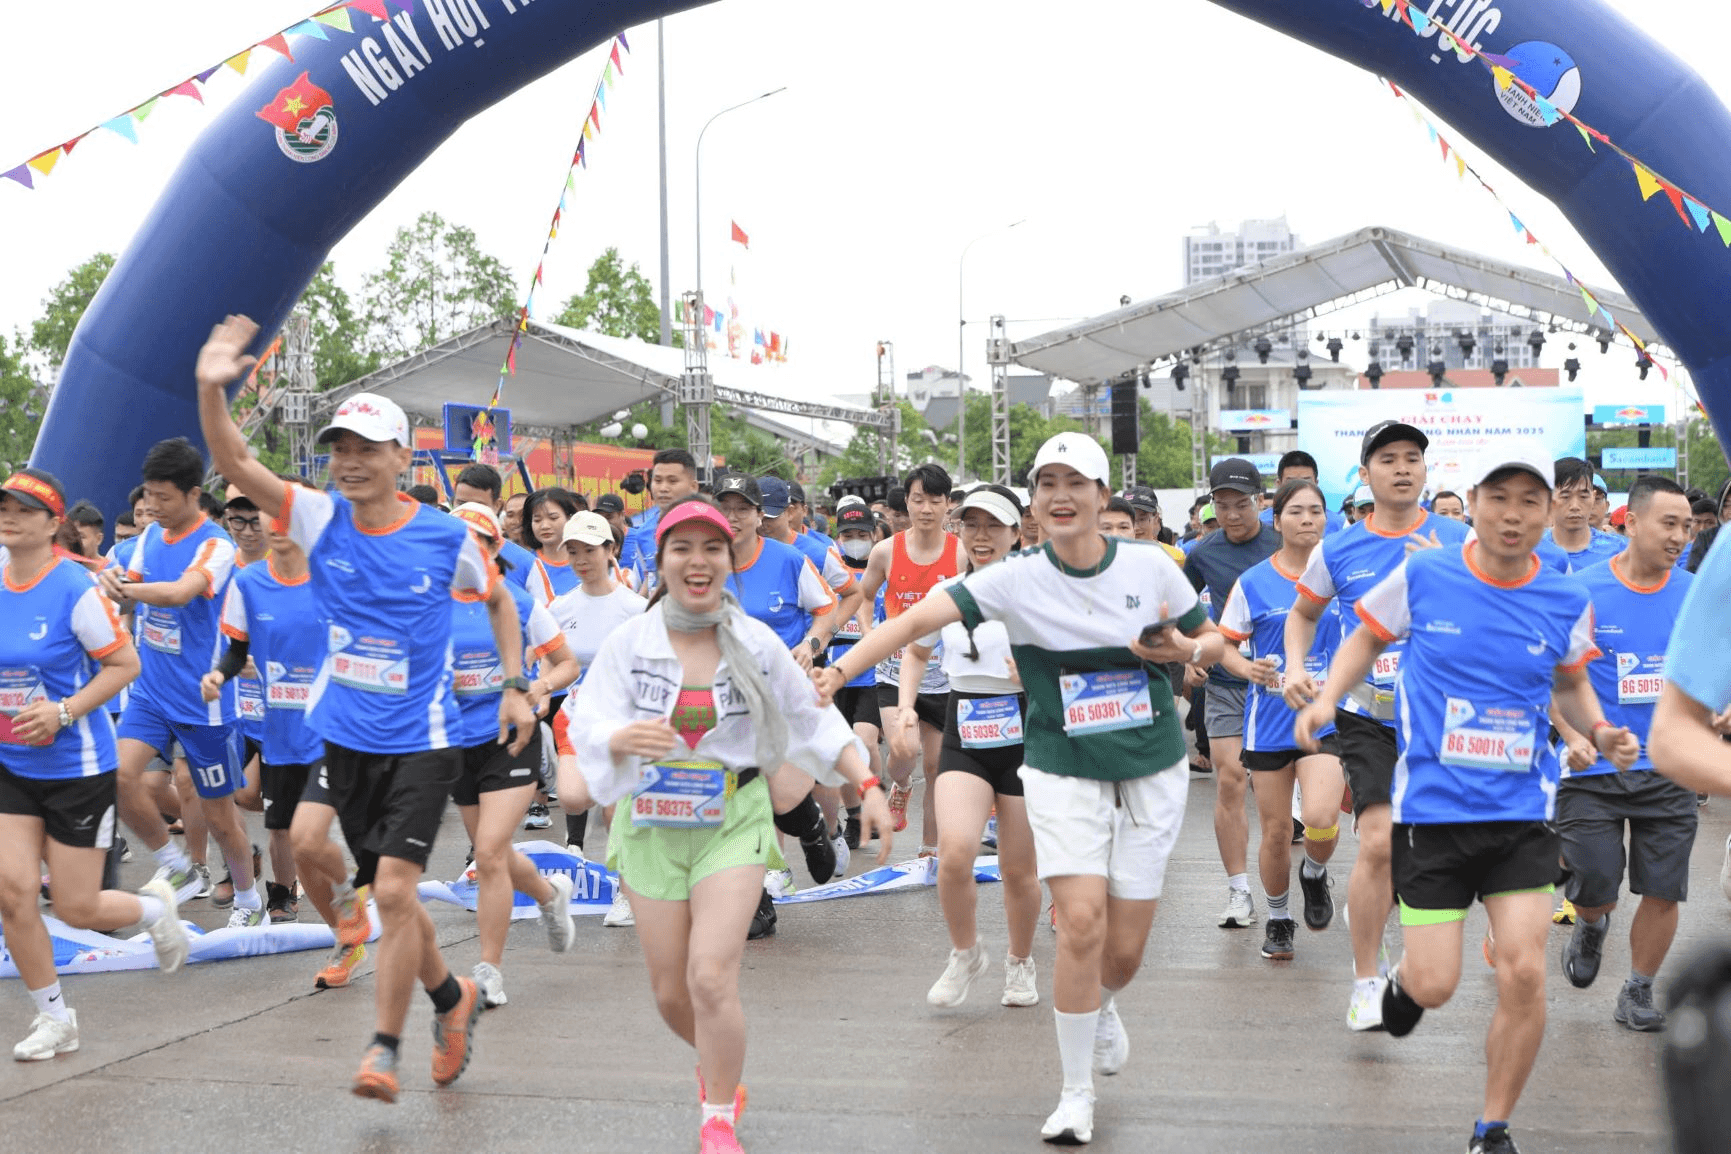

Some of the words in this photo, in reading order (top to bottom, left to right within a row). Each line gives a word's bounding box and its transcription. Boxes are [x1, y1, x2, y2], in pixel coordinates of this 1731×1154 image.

[1518, 107, 1537, 124] NAM
[1516, 427, 1544, 435] 2025
[1375, 658, 1390, 674] BG
[1622, 679, 1635, 694] BG
[1068, 706, 1085, 724] BG
[1087, 701, 1121, 721] 50381
[961, 724, 972, 739] BG
[973, 723, 1000, 739] 50392
[1448, 734, 1464, 753] BG
[1467, 736, 1505, 757] 50018
[198, 763, 225, 788] 10
[636, 797, 654, 815] BG
[656, 799, 693, 817] 50375
